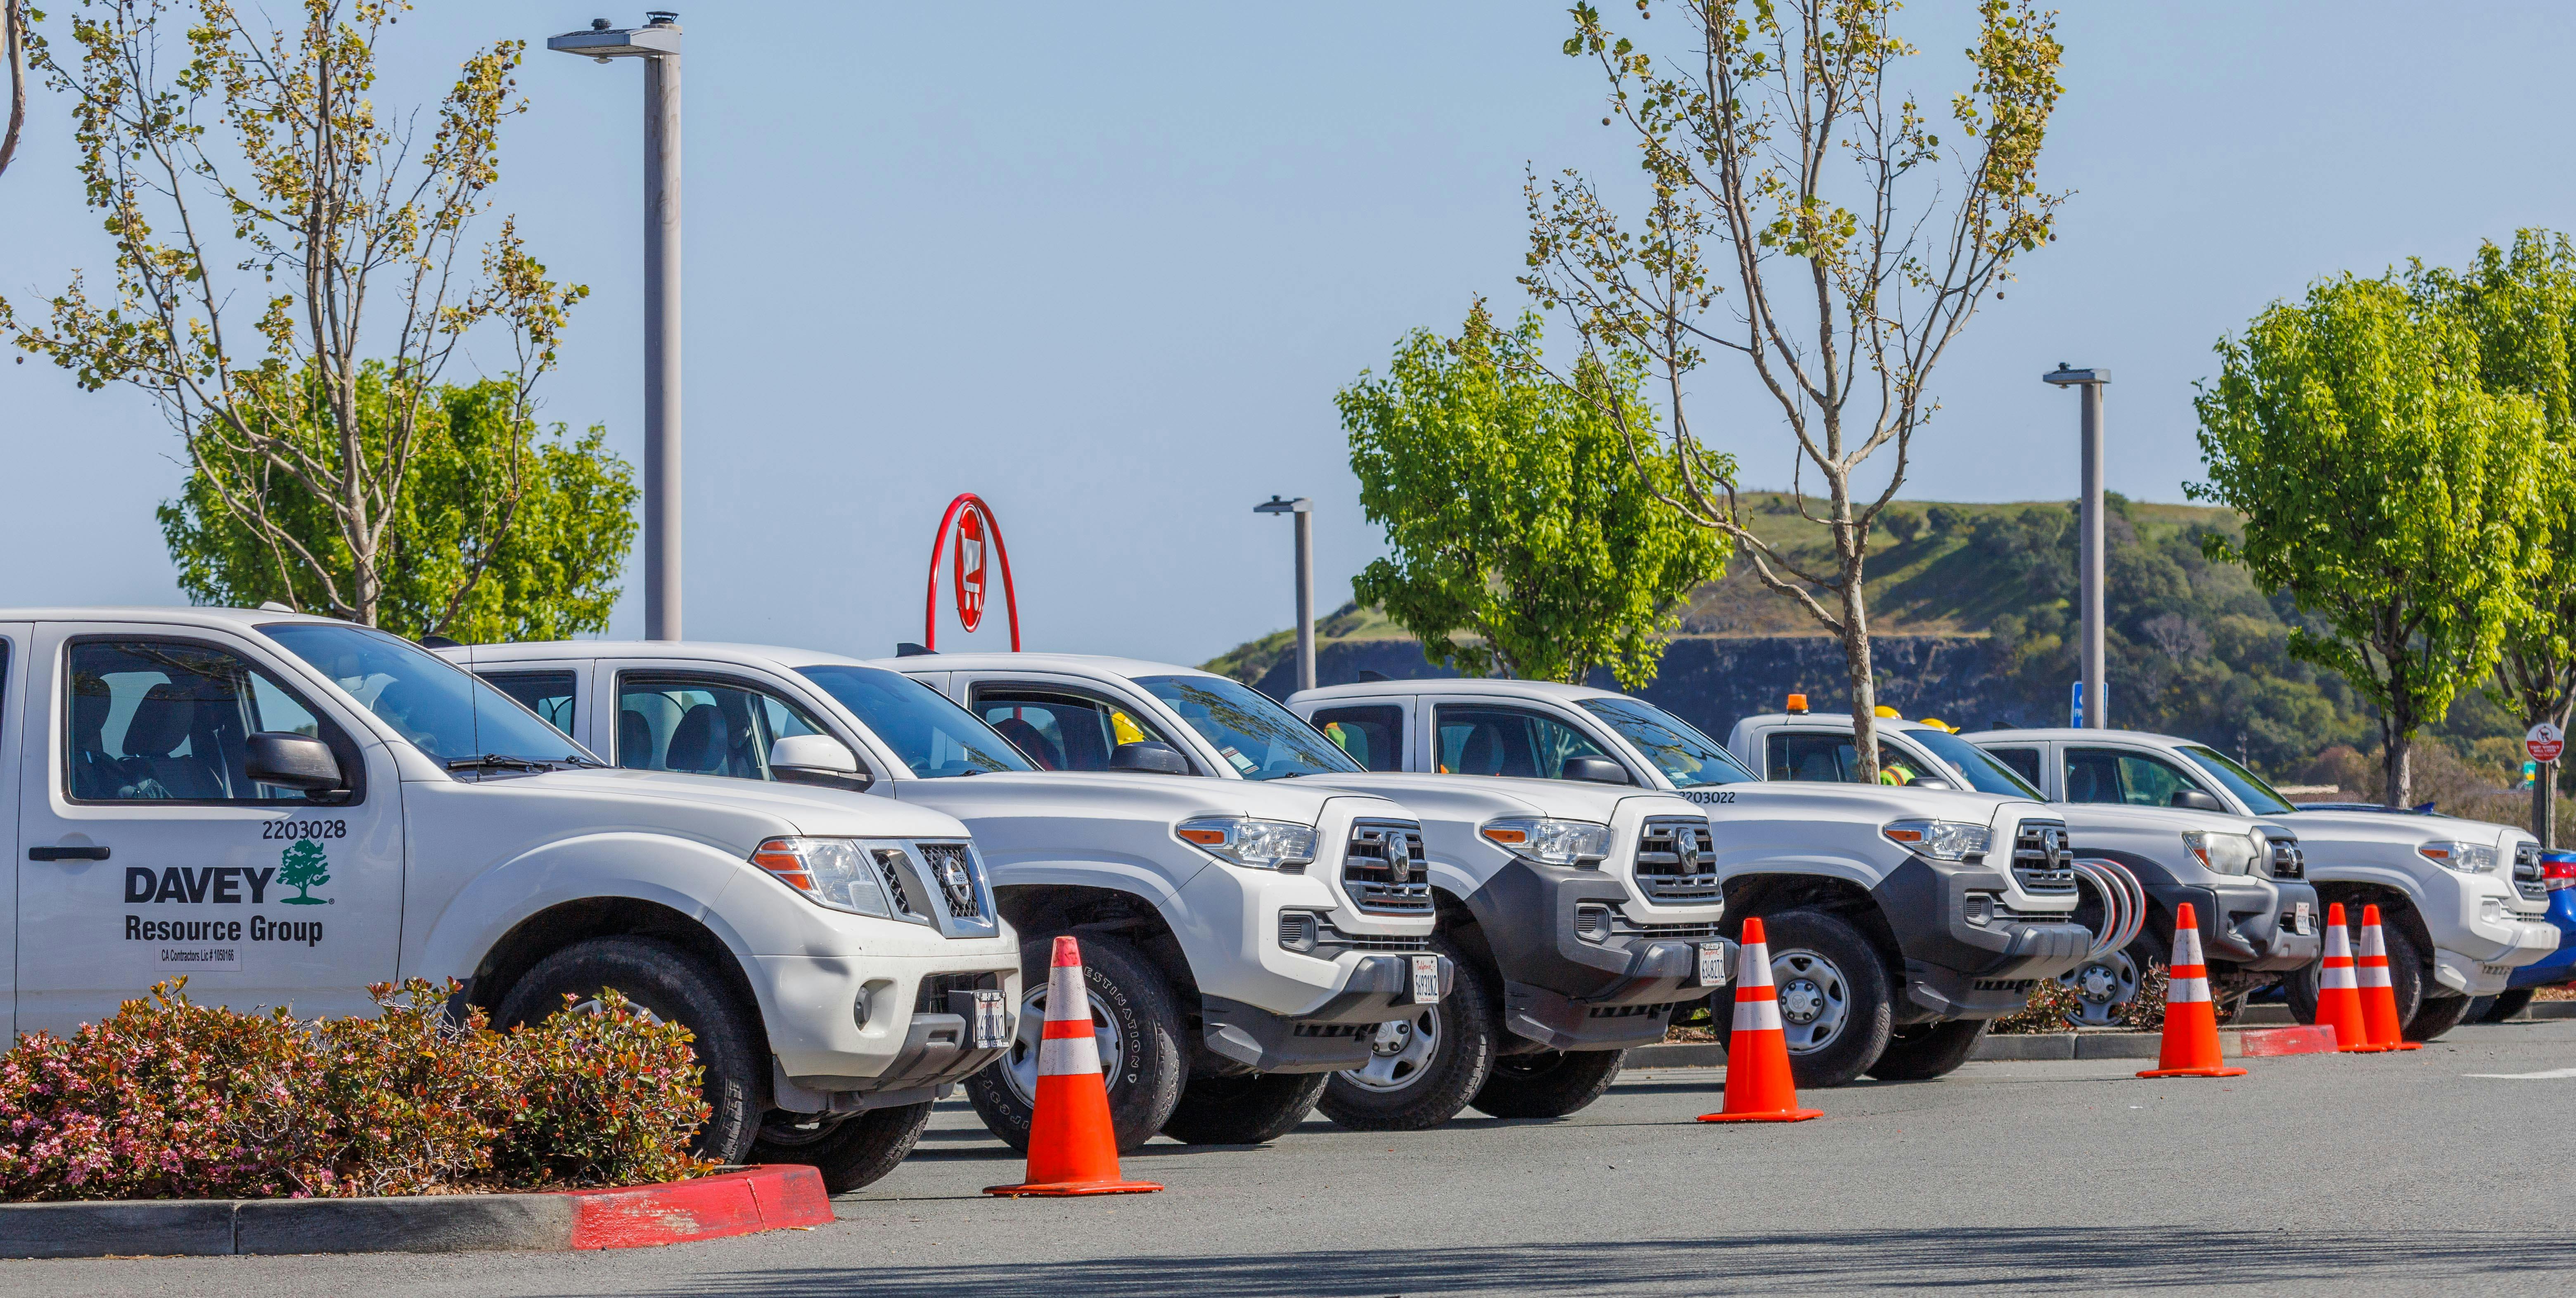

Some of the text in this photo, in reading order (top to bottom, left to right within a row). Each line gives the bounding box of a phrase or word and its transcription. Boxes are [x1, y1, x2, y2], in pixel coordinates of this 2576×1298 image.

[263, 820, 346, 840] 2203028
[125, 867, 276, 904] DAVEY
[126, 915, 323, 947] Resource Group
[162, 949, 169, 962] CA
[170, 949, 200, 962] Contractors
[209, 949, 213, 962] #
[214, 949, 234, 962] 1050166
[1702, 959, 1724, 979] 63482T2
[1083, 966, 1140, 1068] ESTINATION
